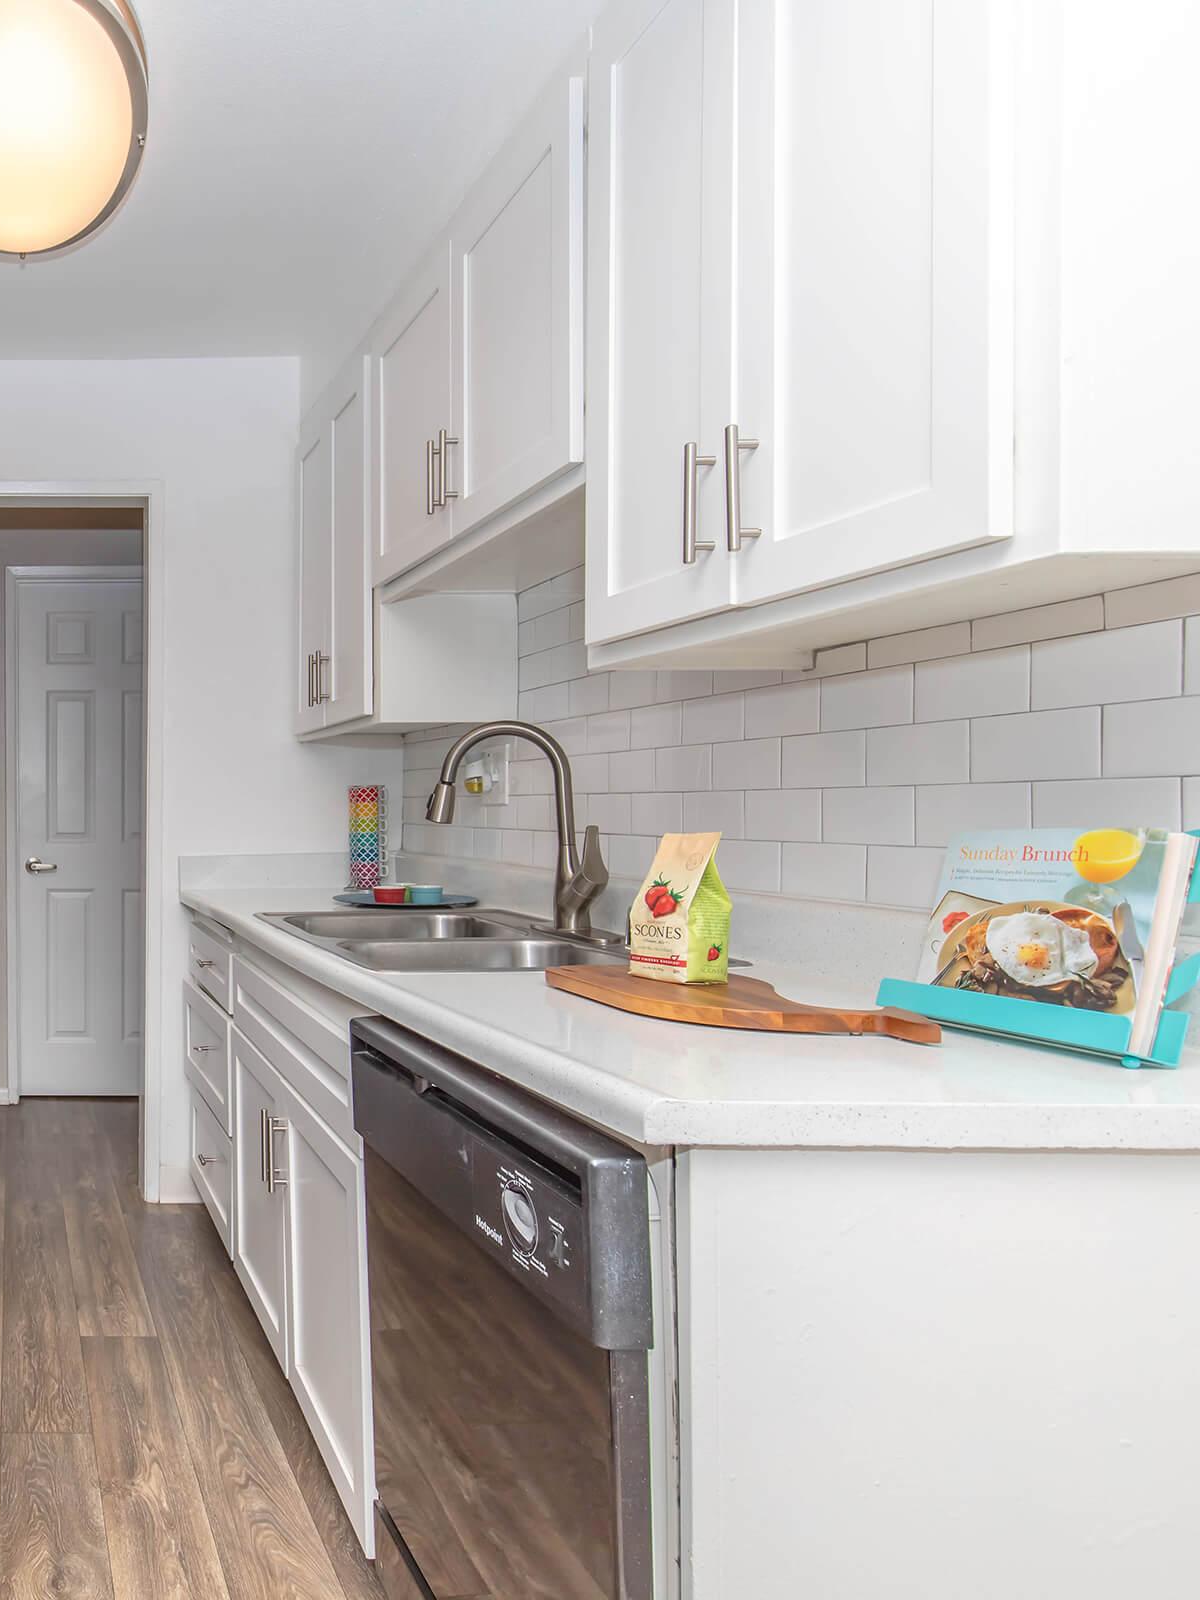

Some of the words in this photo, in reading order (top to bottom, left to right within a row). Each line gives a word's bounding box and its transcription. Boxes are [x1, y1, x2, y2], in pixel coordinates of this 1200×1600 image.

[959, 845, 1019, 865] Sunday
[1022, 844, 1089, 863] Brunch
[634, 923, 682, 940] SCONES
[475, 1214, 503, 1247] Hotpoint
